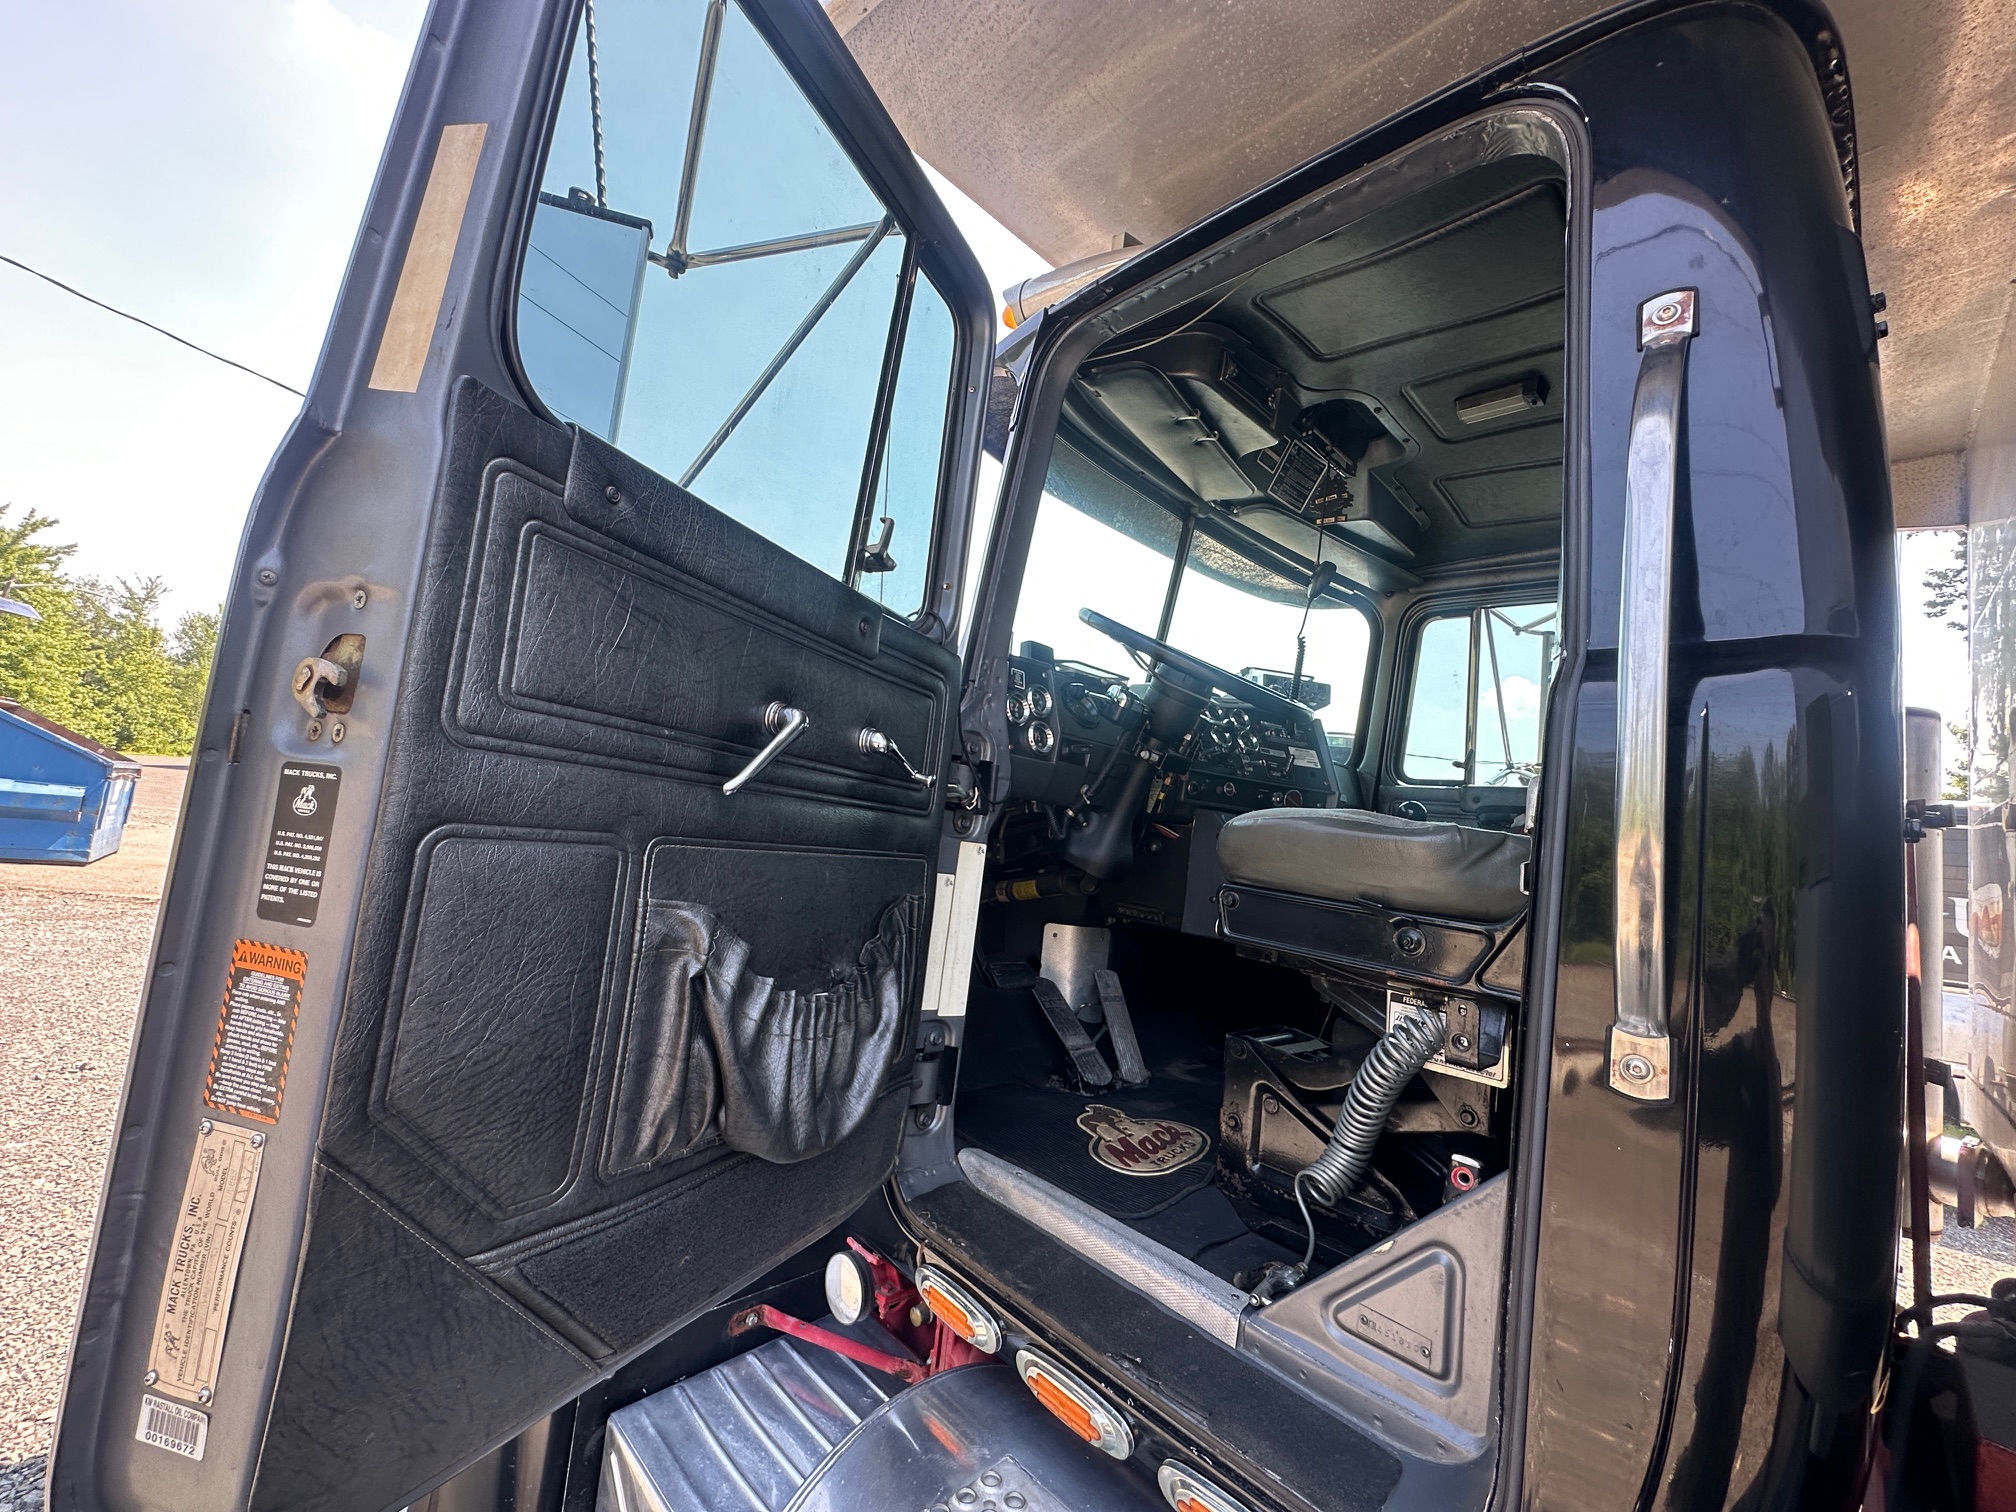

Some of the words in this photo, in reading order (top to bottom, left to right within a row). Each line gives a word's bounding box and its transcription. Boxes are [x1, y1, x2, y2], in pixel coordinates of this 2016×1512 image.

[283, 768, 301, 776] MACK
[301, 770, 326, 779] TRUCKS,
[294, 798, 316, 810] Mack
[264, 873, 290, 883] COVERED
[298, 878, 311, 886] ONE
[311, 880, 320, 888] OR
[266, 863, 279, 871] THIS
[278, 864, 295, 873] MACK
[294, 867, 316, 876] VEHICLE
[260, 893, 285, 904] PATENTS.
[262, 883, 279, 892] MORE
[288, 887, 299, 895] THE
[299, 889, 318, 898] LISTED
[248, 952, 302, 974] WARNING
[1105, 1123, 1191, 1167] Mack
[1150, 1140, 1196, 1166] TRUCKS
[218, 1166, 228, 1192] MODEL
[166, 1278, 182, 1315] MACK
[174, 1221, 196, 1275] TRUCKS,
[188, 1192, 202, 1218] INC.
[181, 1308, 189, 1324] THE
[185, 1281, 195, 1308] TRUCK
[190, 1248, 201, 1280] CAPITAL
[197, 1237, 204, 1248] OF
[204, 1191, 215, 1220] WORLD
[181, 1255, 194, 1298] ALLENTOWN,
[176, 1349, 188, 1383] VEHICLE
[183, 1286, 200, 1348] IDENTIFICATION
[196, 1253, 207, 1286] NUMBER
[203, 1232, 212, 1252] (VIN)
[153, 1399, 175, 1414] RASTALL
[175, 1406, 183, 1417] OIL
[144, 1430, 196, 1456] 00169672
